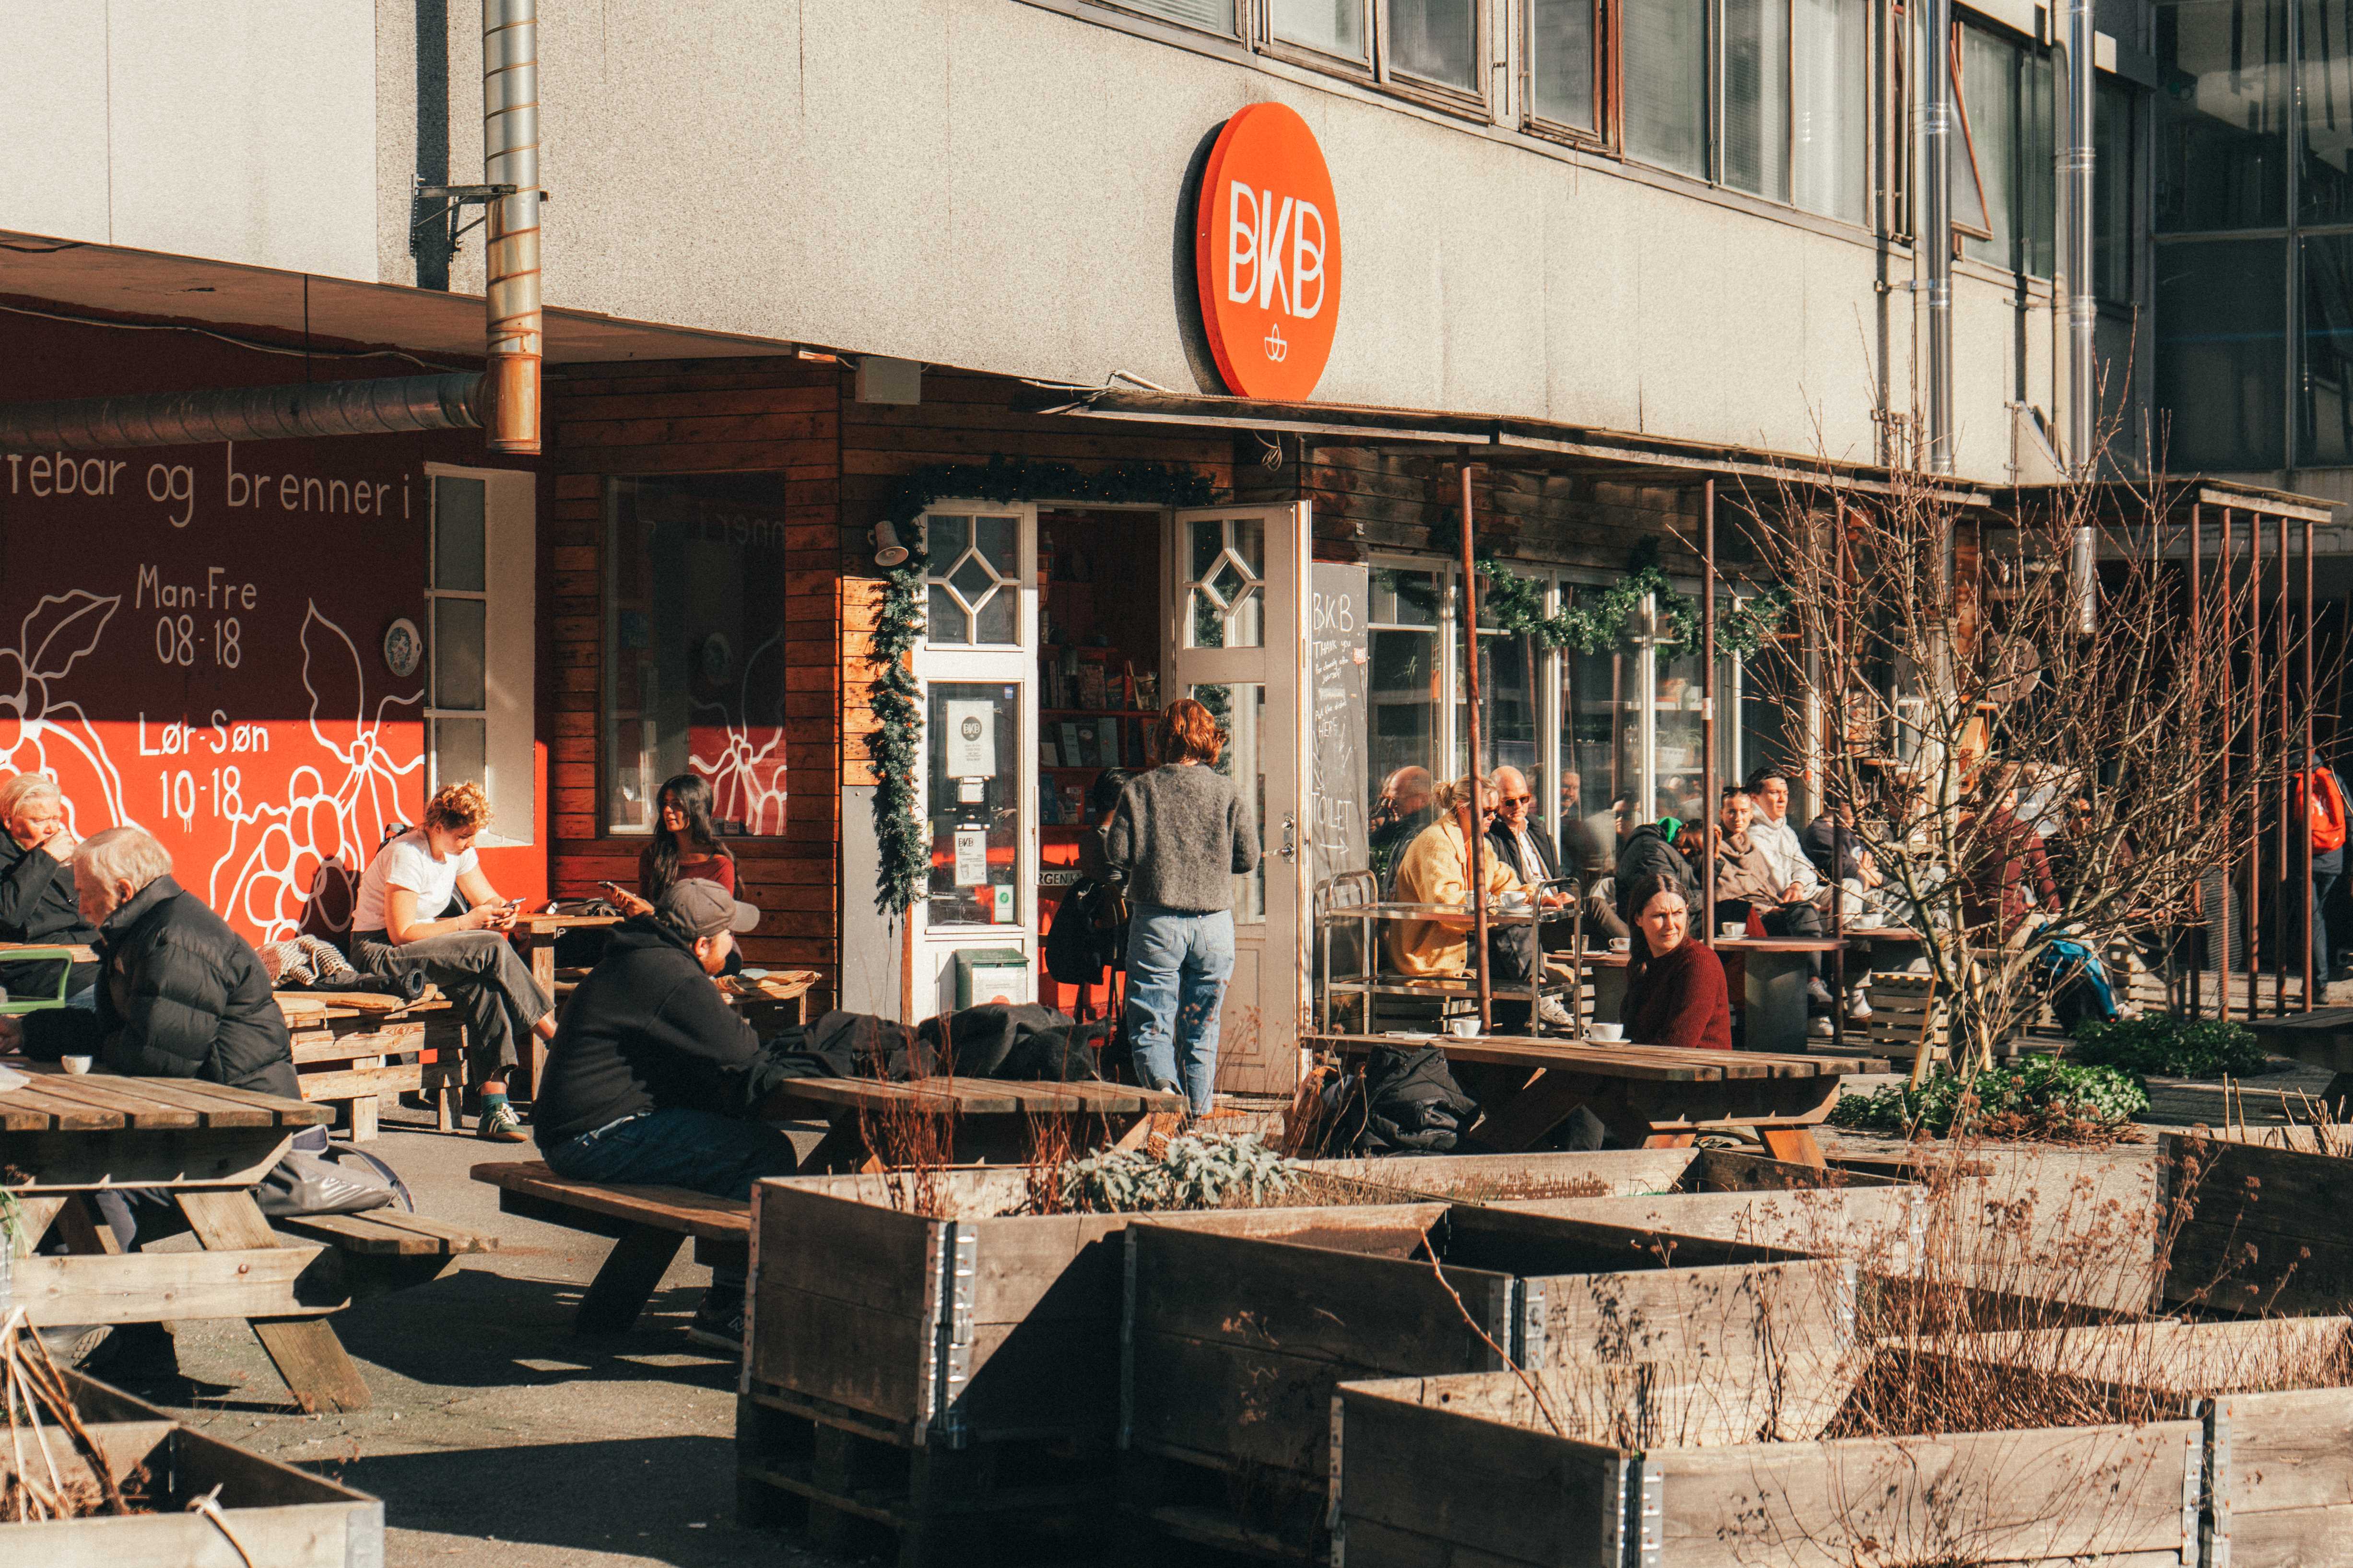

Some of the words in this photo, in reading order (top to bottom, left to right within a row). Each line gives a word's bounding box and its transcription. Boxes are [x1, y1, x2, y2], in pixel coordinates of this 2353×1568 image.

[1228, 180, 1326, 319] BKB
[147, 463, 193, 527] og
[227, 441, 409, 518] brenneri
[136, 563, 257, 609] Man-Fre
[1313, 593, 1353, 632] BKB
[1312, 640, 1337, 659] THANK
[963, 723, 980, 734] BKB
[1312, 792, 1352, 833] TOILET
[958, 837, 974, 847] BKB
